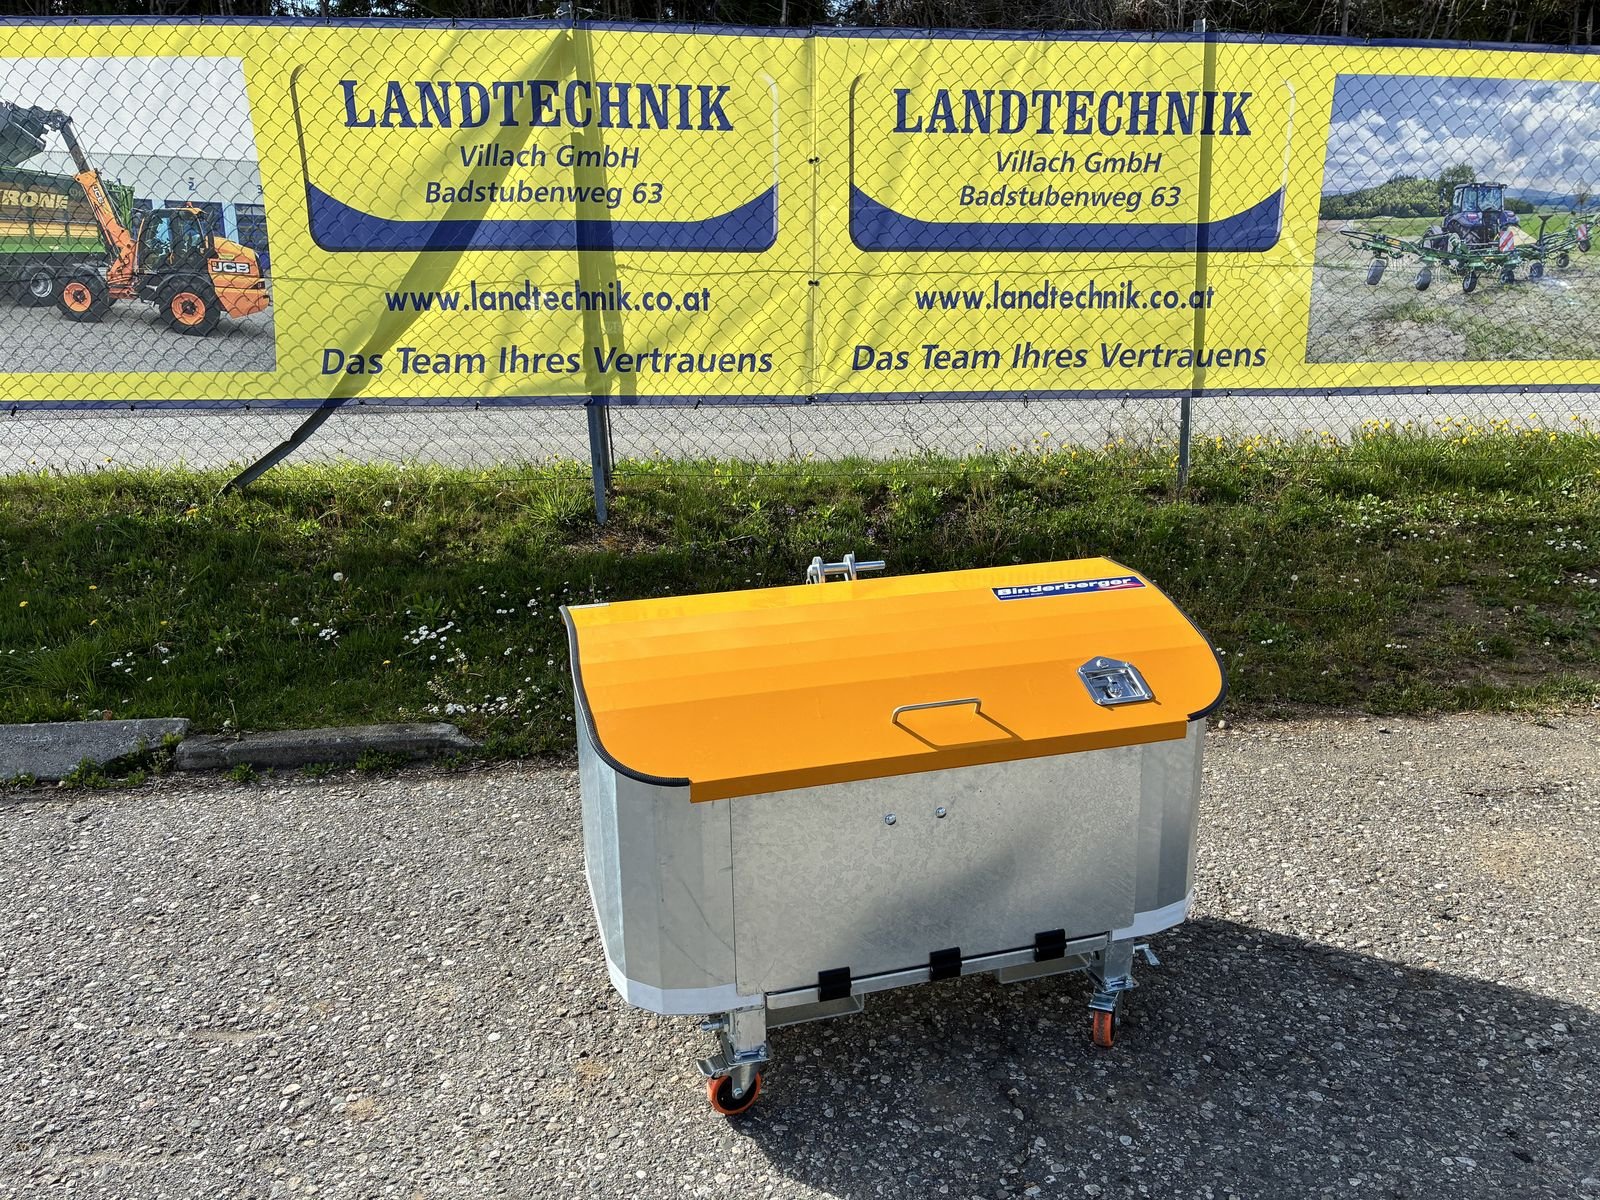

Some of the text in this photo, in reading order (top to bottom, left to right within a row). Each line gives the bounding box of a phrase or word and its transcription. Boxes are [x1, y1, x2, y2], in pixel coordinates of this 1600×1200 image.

[339, 79, 734, 131] LANDTECHNIK
[893, 88, 1252, 136] LANDTECHNIK
[460, 145, 640, 169] Villach GmbH
[996, 151, 1162, 174] Villach GmbH
[0, 189, 69, 209] RONE
[425, 181, 664, 209] Badstubenweg 63
[959, 185, 1181, 212] Badstubenweg 63
[212, 261, 250, 273] JCB
[385, 280, 710, 312] www.landtechnik.co.at
[915, 280, 1214, 309] www.landtechnik.co.at
[322, 345, 773, 375] Das Team Ihres Vertrauens
[852, 342, 1266, 371] Das Team Ihres Vertrauens
[997, 577, 1132, 596] Binderberger
